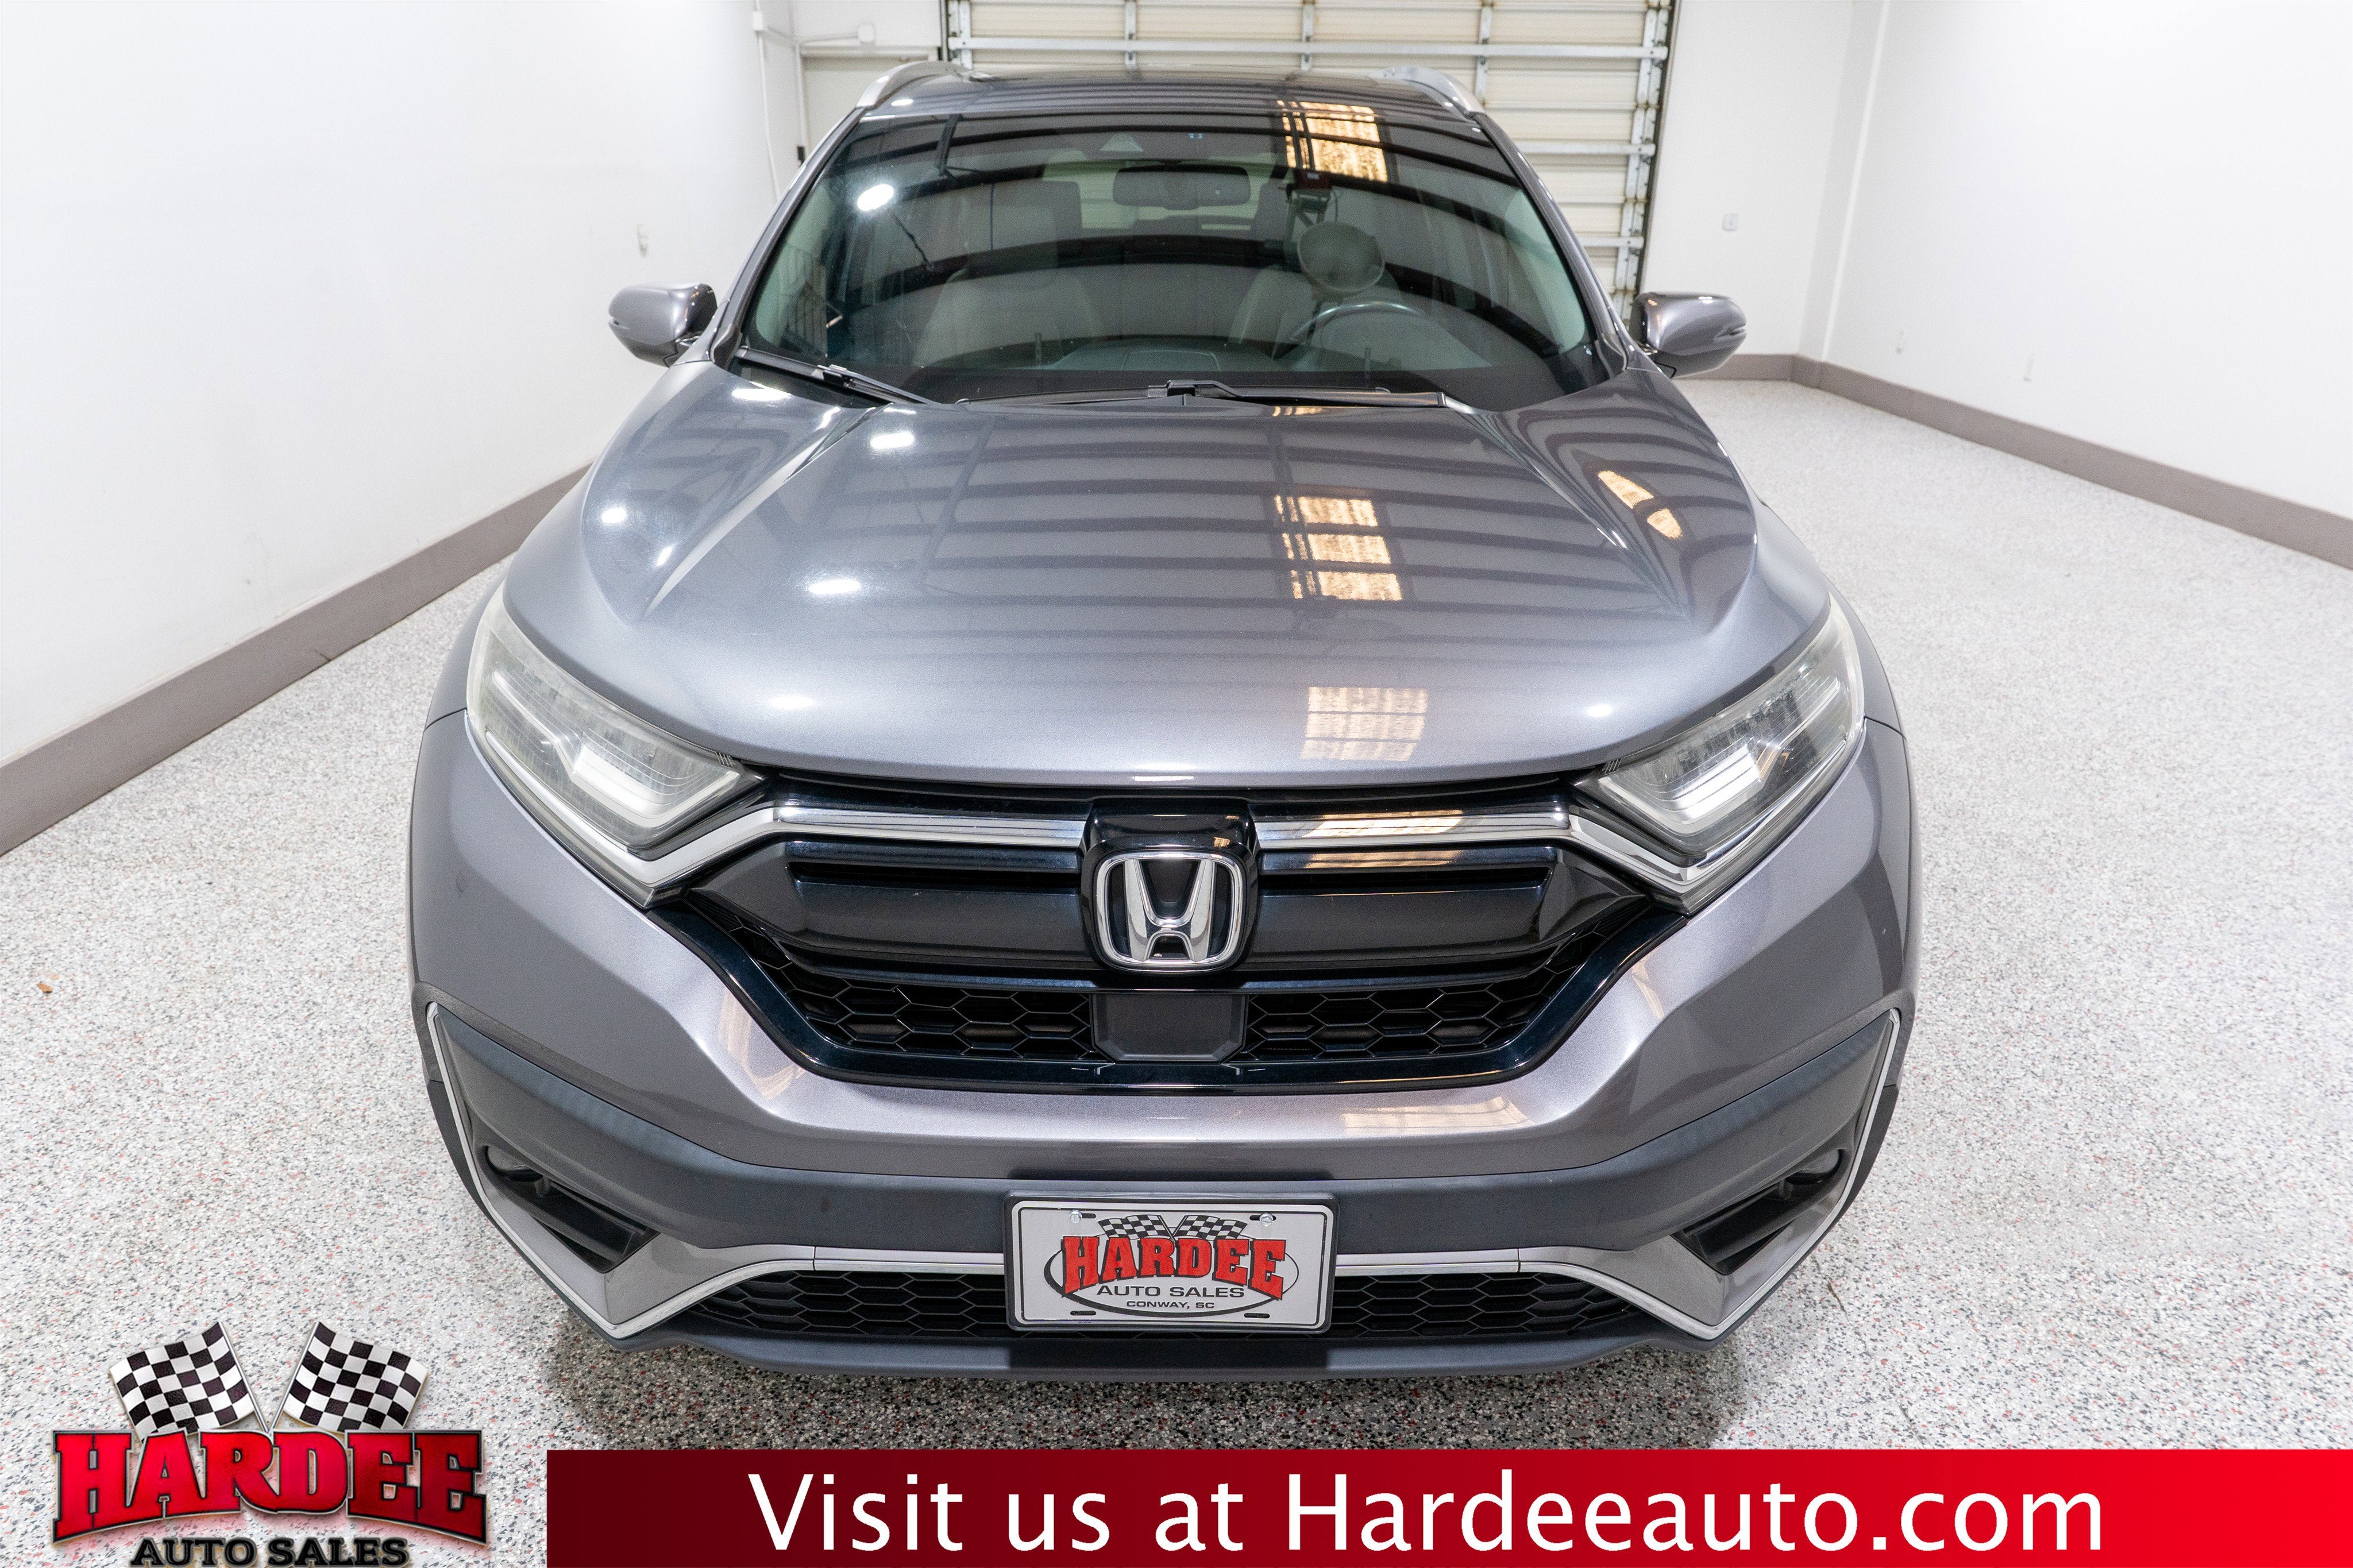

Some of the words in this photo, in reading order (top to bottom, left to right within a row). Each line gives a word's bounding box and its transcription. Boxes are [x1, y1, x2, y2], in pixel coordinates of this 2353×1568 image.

[1061, 1236, 1286, 1300] HARDEE
[1097, 1285, 1161, 1297] AUTO
[1170, 1286, 1245, 1298] SALES
[1126, 1300, 1190, 1310] CONWAY,
[1195, 1301, 1215, 1309] SC
